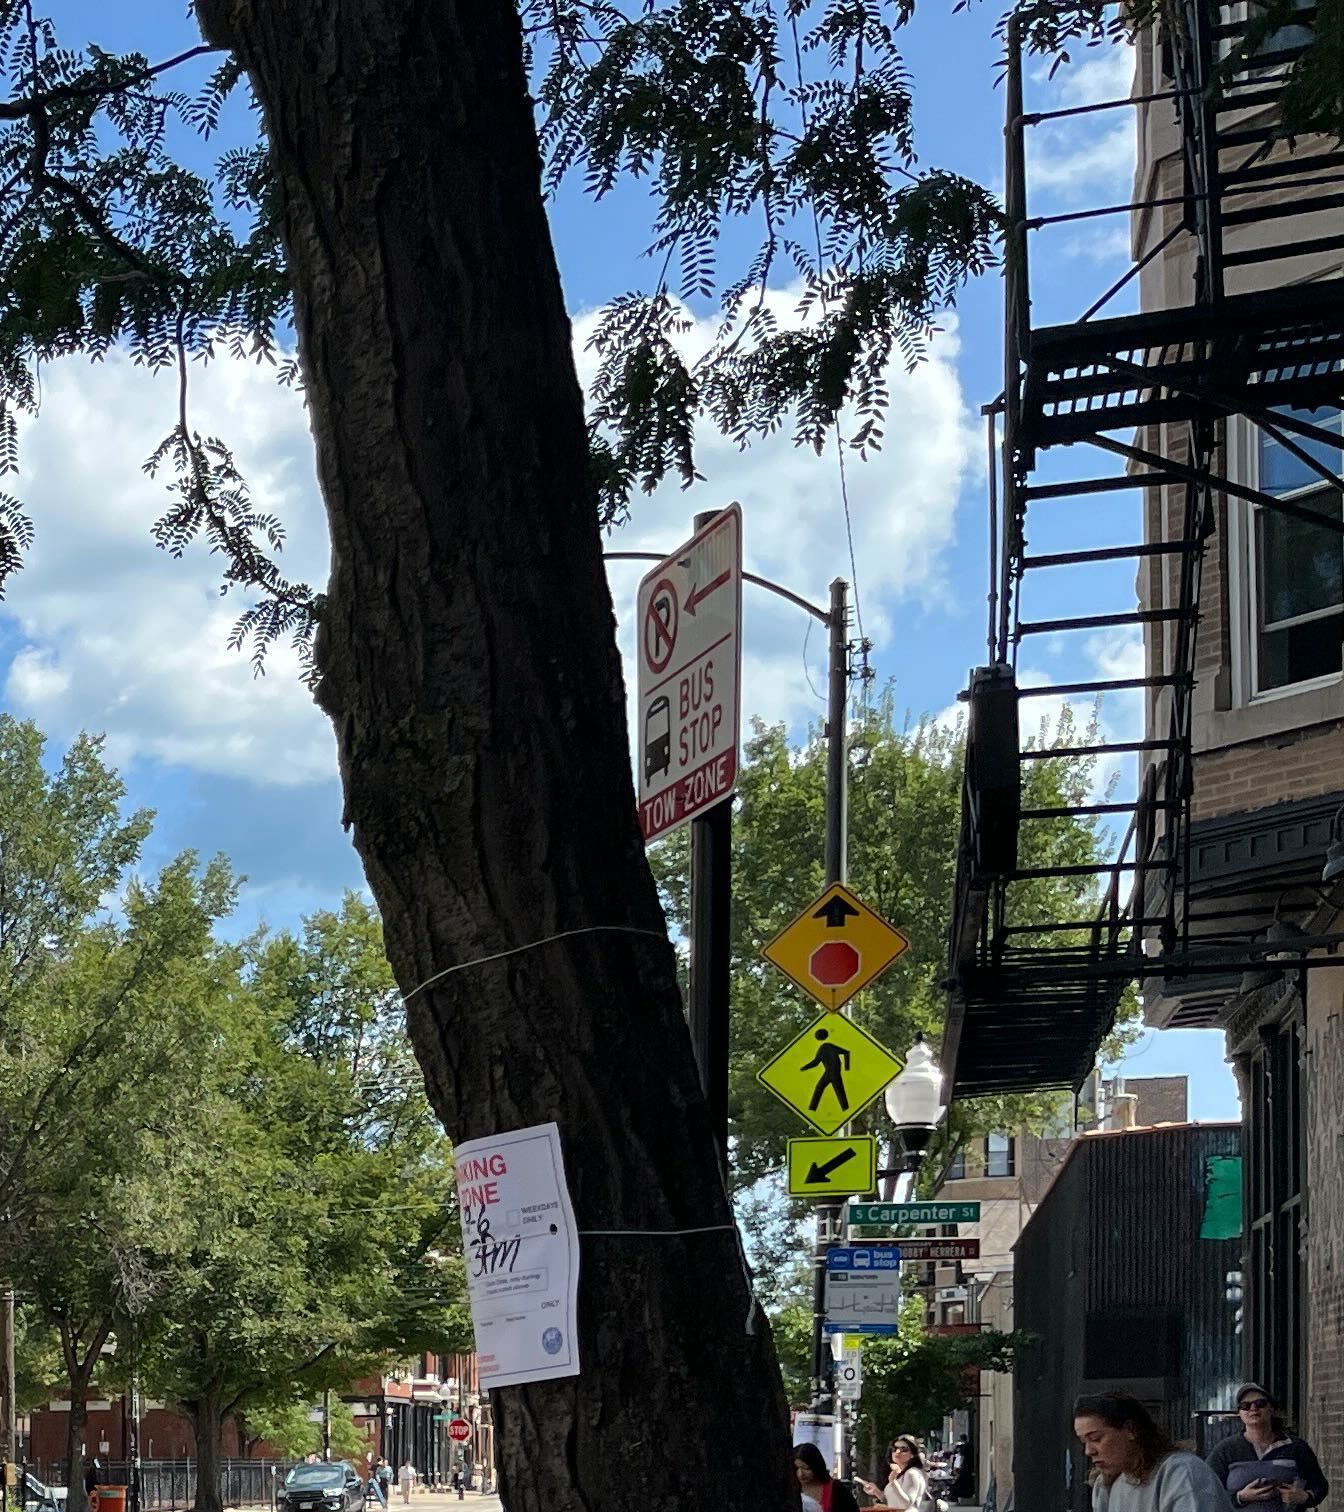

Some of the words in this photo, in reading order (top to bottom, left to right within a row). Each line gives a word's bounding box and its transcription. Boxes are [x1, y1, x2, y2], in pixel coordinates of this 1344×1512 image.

[679, 660, 713, 720] BUS
[679, 703, 722, 767] STOP
[644, 787, 676, 834] TOW
[683, 755, 727, 812] ZONE
[856, 1209, 863, 1220] S
[868, 1206, 957, 1223] Carpenter
[873, 1250, 893, 1259] bus
[873, 1258, 897, 1269] stop
[449, 1425, 469, 1436] STOP
